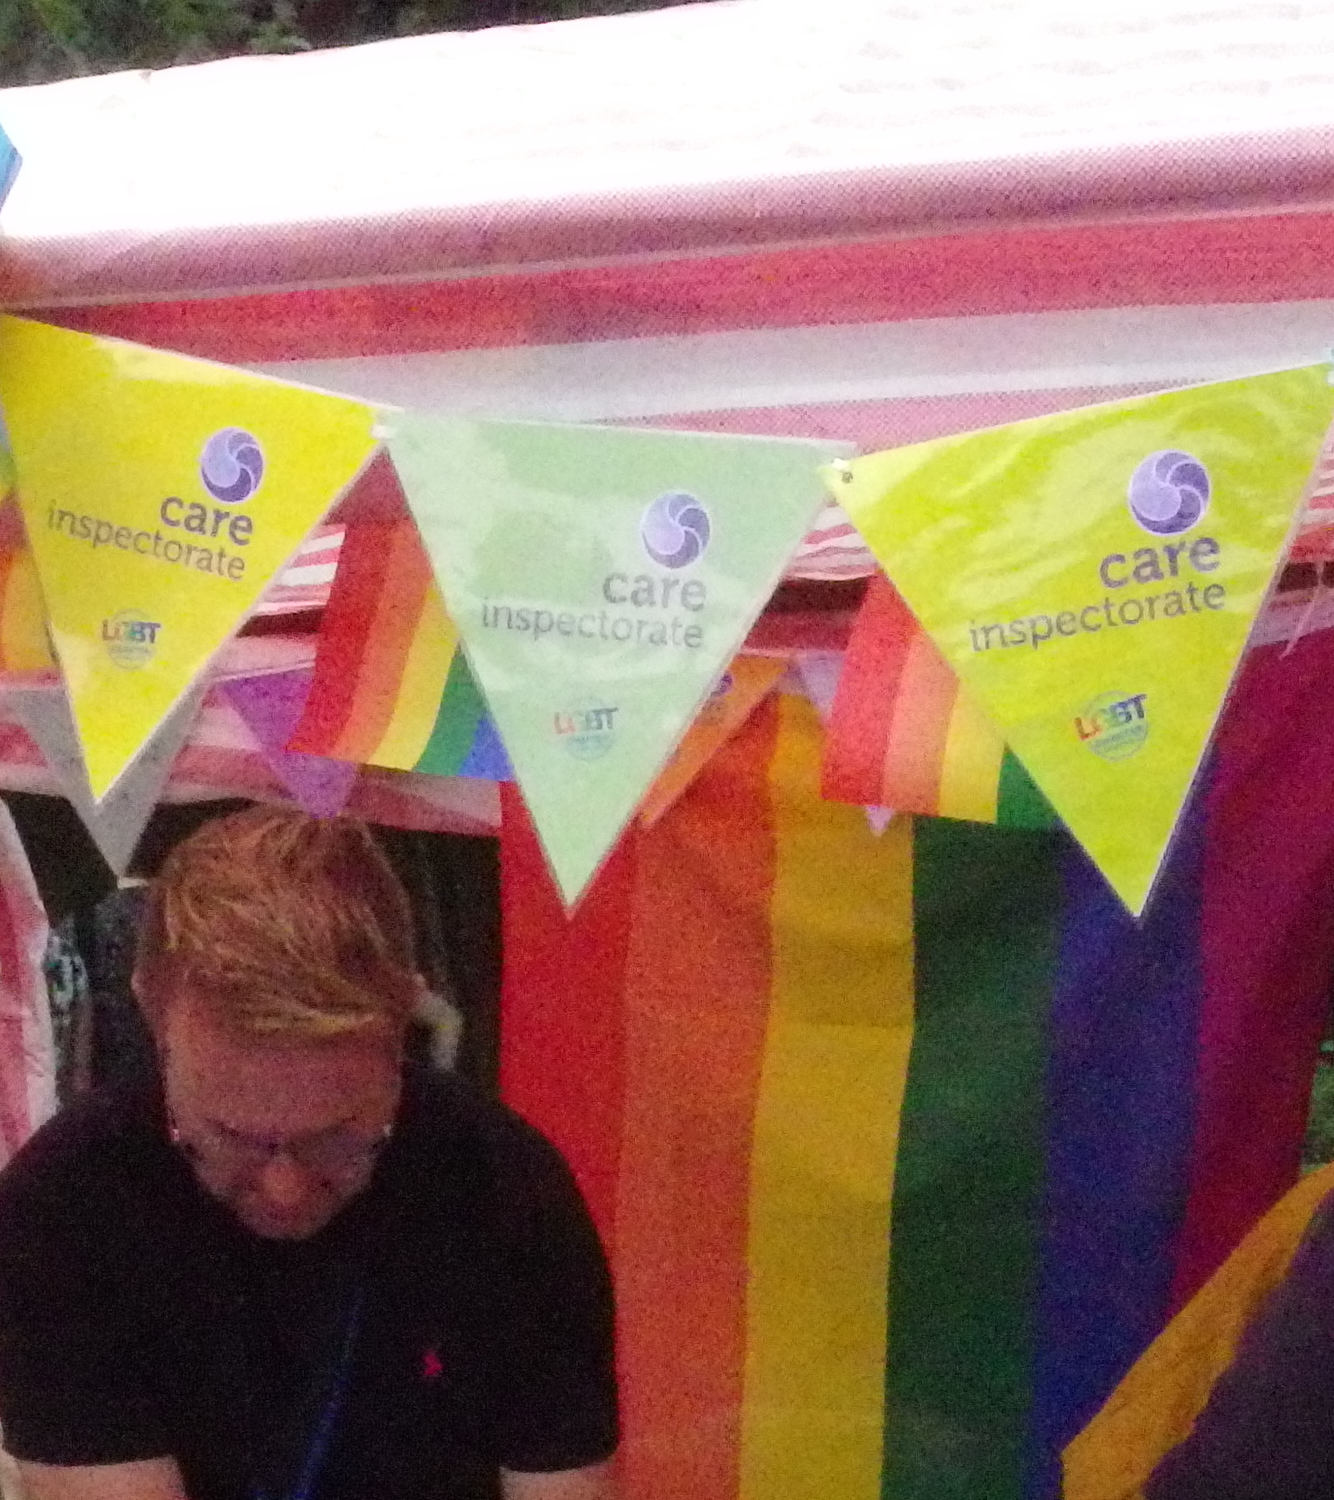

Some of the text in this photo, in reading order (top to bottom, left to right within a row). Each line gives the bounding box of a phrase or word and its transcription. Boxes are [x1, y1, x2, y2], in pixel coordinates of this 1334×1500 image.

[48, 504, 247, 582] inspectorate
[161, 496, 255, 546] care
[1100, 533, 1222, 590] care
[603, 569, 708, 611] care
[969, 578, 1228, 653] inspectorate
[482, 598, 706, 650] inspectorate
